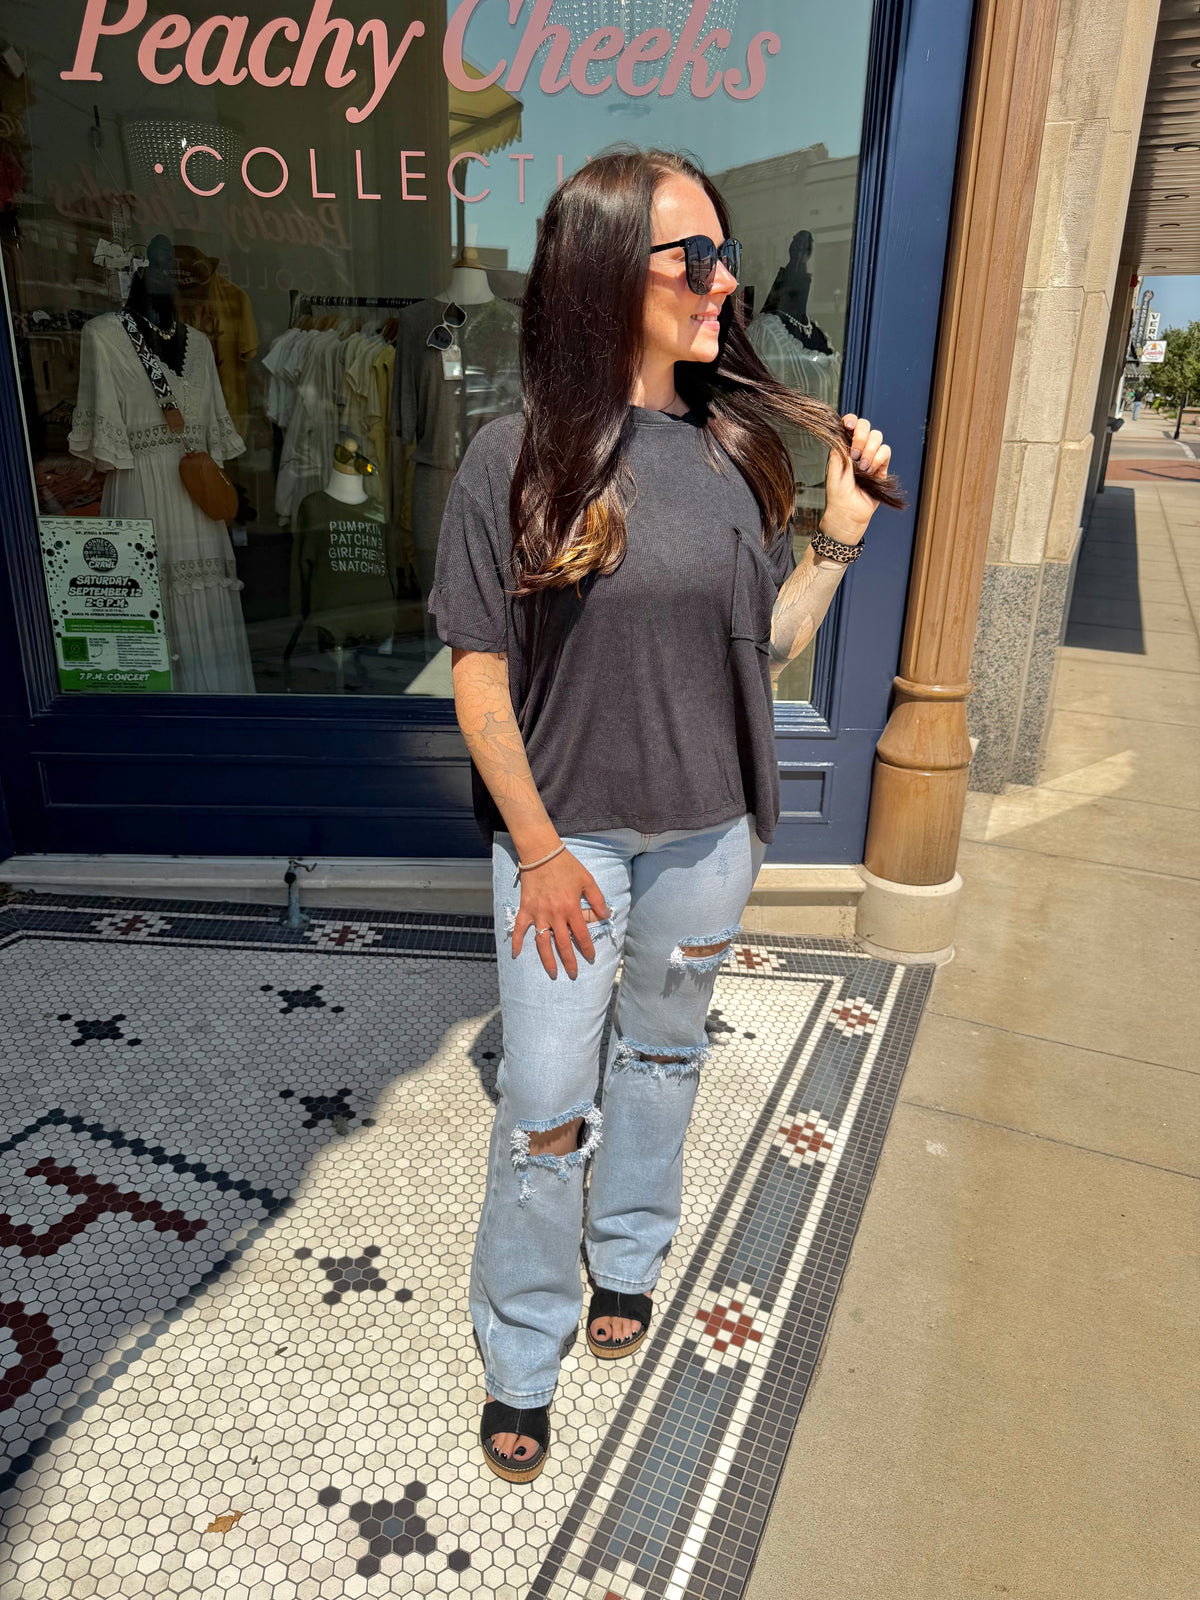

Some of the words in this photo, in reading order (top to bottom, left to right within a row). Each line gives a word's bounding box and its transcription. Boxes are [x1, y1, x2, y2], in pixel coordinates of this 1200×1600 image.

[60, 0, 425, 123] Peachy
[443, 0, 782, 100] Cheeks
[181, 145, 592, 203] COLLECTI
[329, 521, 382, 535] PUMPKIN
[76, 575, 132, 586] SATURDAY,
[68, 586, 129, 597] SEPTEMBER
[130, 588, 143, 597] 12
[106, 598, 129, 608] P.M.
[106, 673, 150, 681] CONCERT
